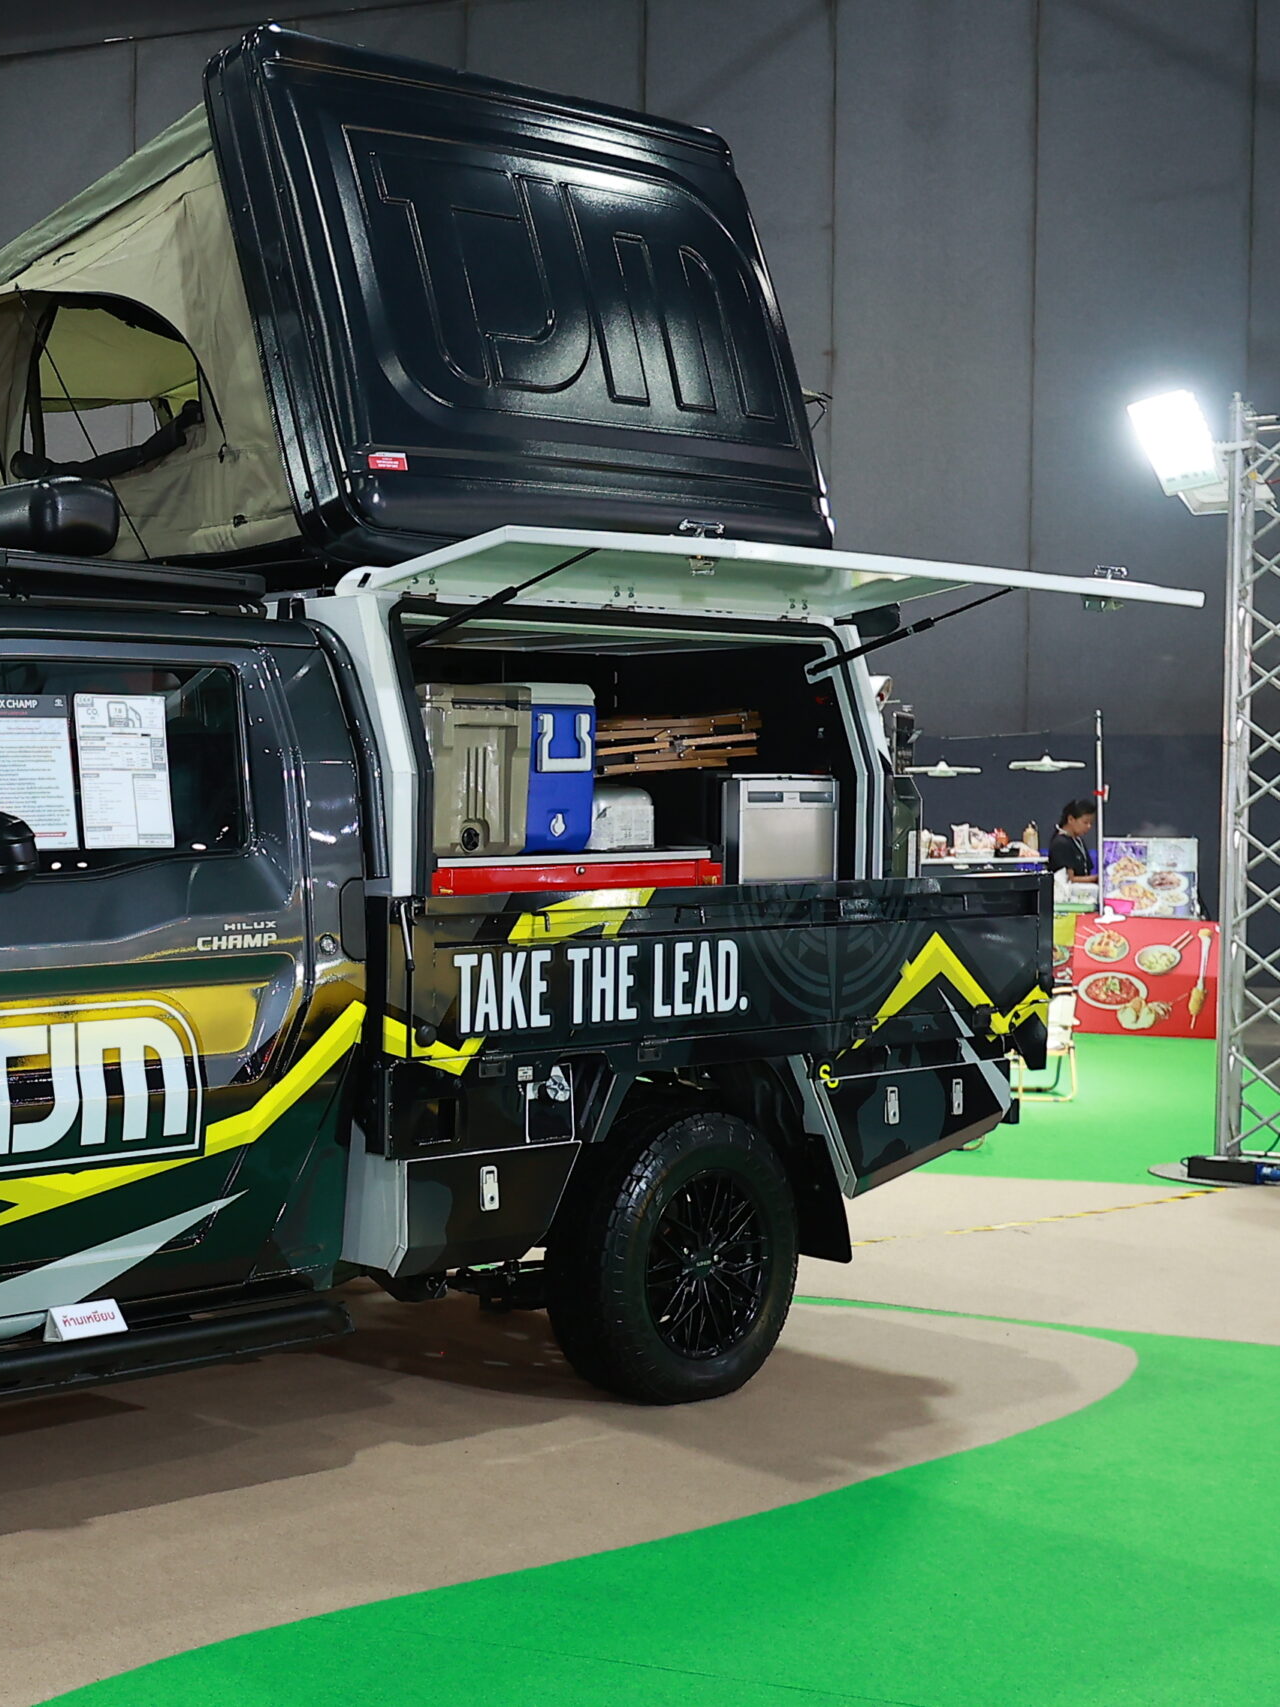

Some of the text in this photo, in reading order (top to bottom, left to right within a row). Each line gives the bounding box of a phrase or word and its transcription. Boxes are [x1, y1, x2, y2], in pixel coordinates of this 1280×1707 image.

[6, 698, 38, 709] CHAMP
[223, 920, 277, 932] HILUX
[196, 932, 278, 952] CHAMP
[453, 939, 749, 1034] TAKE THE LEAD.
[62, 1310, 116, 1328] ห้ามเหยียบ
